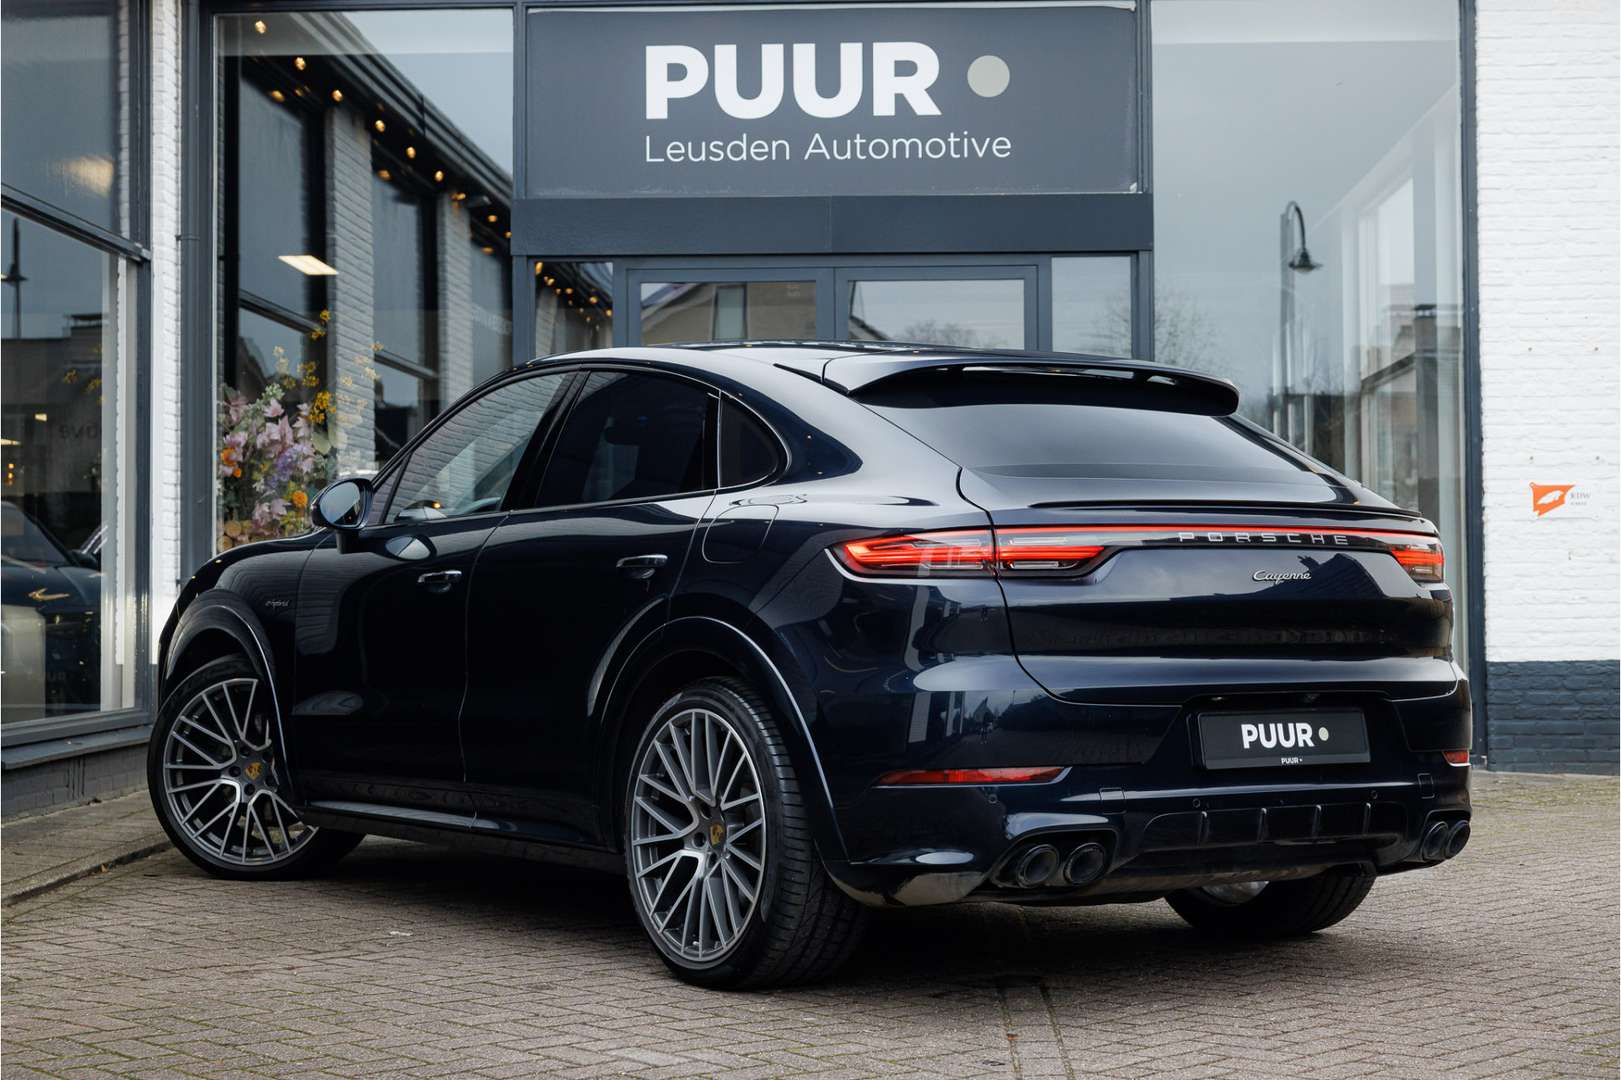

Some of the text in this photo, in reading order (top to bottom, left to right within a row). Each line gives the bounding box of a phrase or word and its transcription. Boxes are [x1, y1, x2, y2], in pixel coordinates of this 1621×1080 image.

[645, 41, 942, 119] PUUR
[645, 130, 1012, 162] Leusden Automotive
[1178, 532, 1349, 545] PORSCHE
[1252, 569, 1312, 585] Cayenne
[1240, 722, 1315, 749] PUUR
[1280, 757, 1299, 765] PUUR
